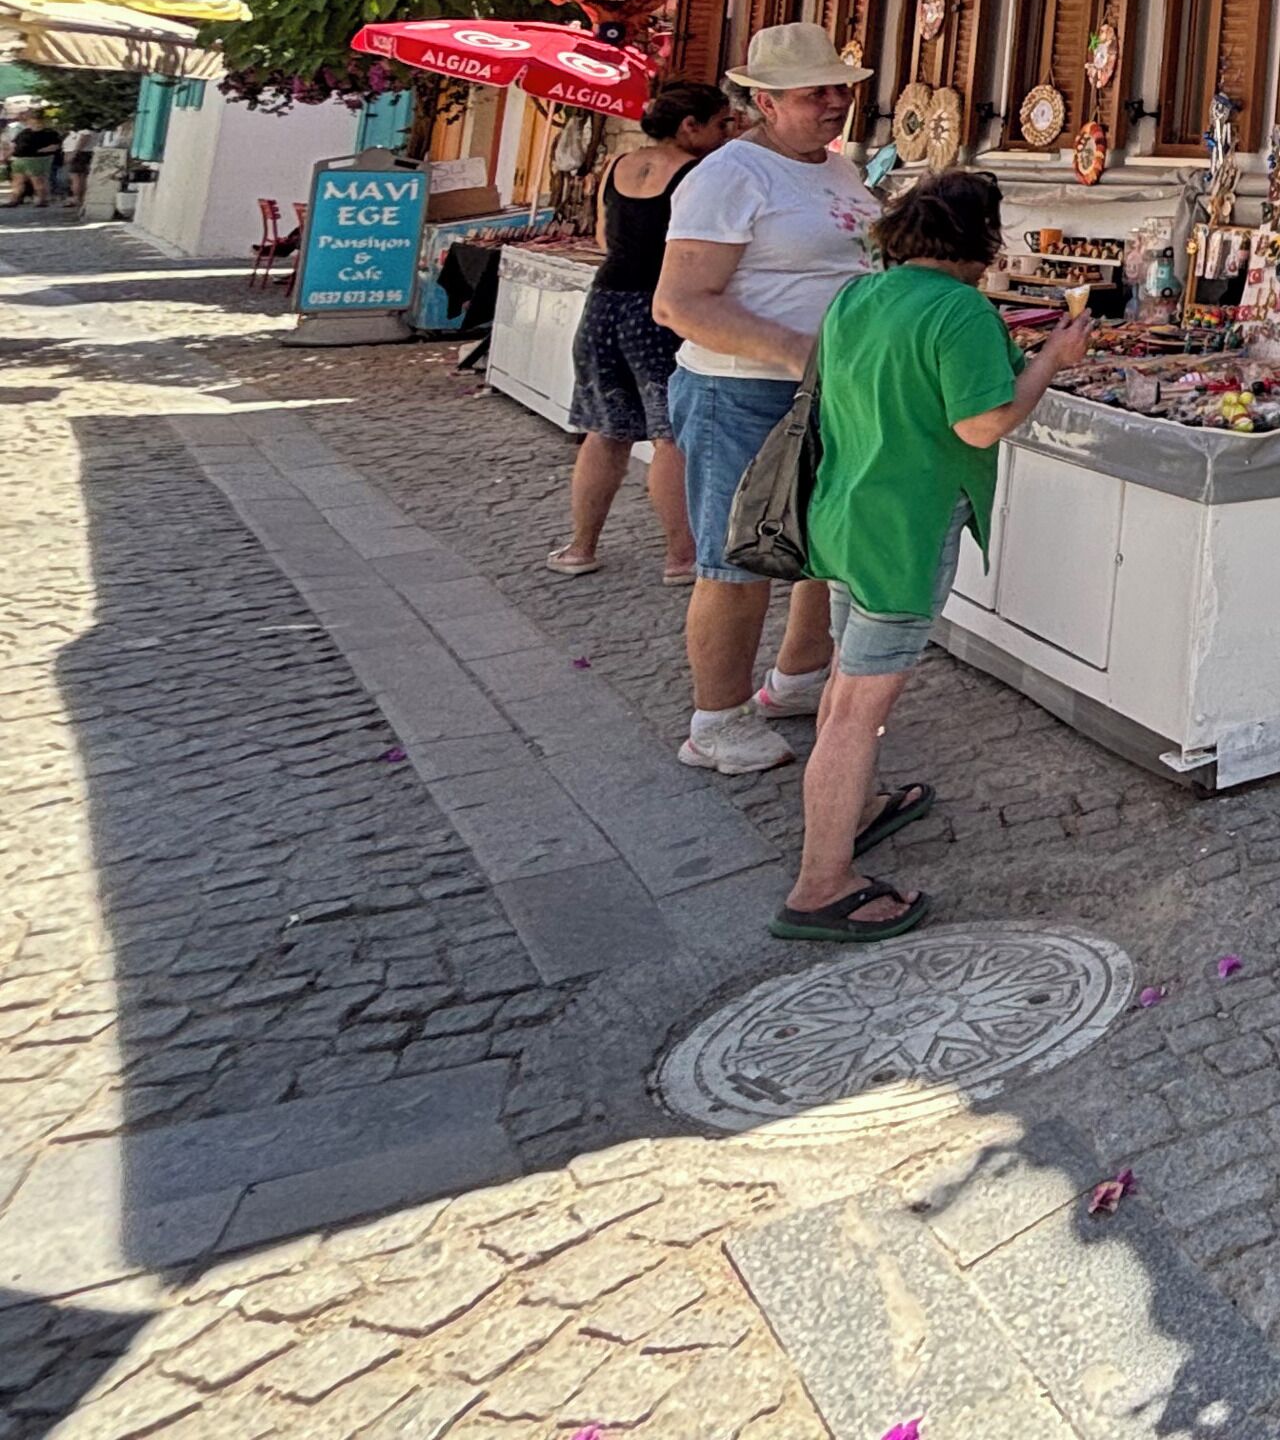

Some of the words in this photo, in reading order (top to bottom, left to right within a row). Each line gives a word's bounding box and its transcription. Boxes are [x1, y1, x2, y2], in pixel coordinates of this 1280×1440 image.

[337, 205, 401, 226] EGE
[318, 235, 411, 252] Pansiyon
[353, 252, 373, 265] &
[337, 265, 383, 281] Cafe
[309, 291, 341, 305] 0537
